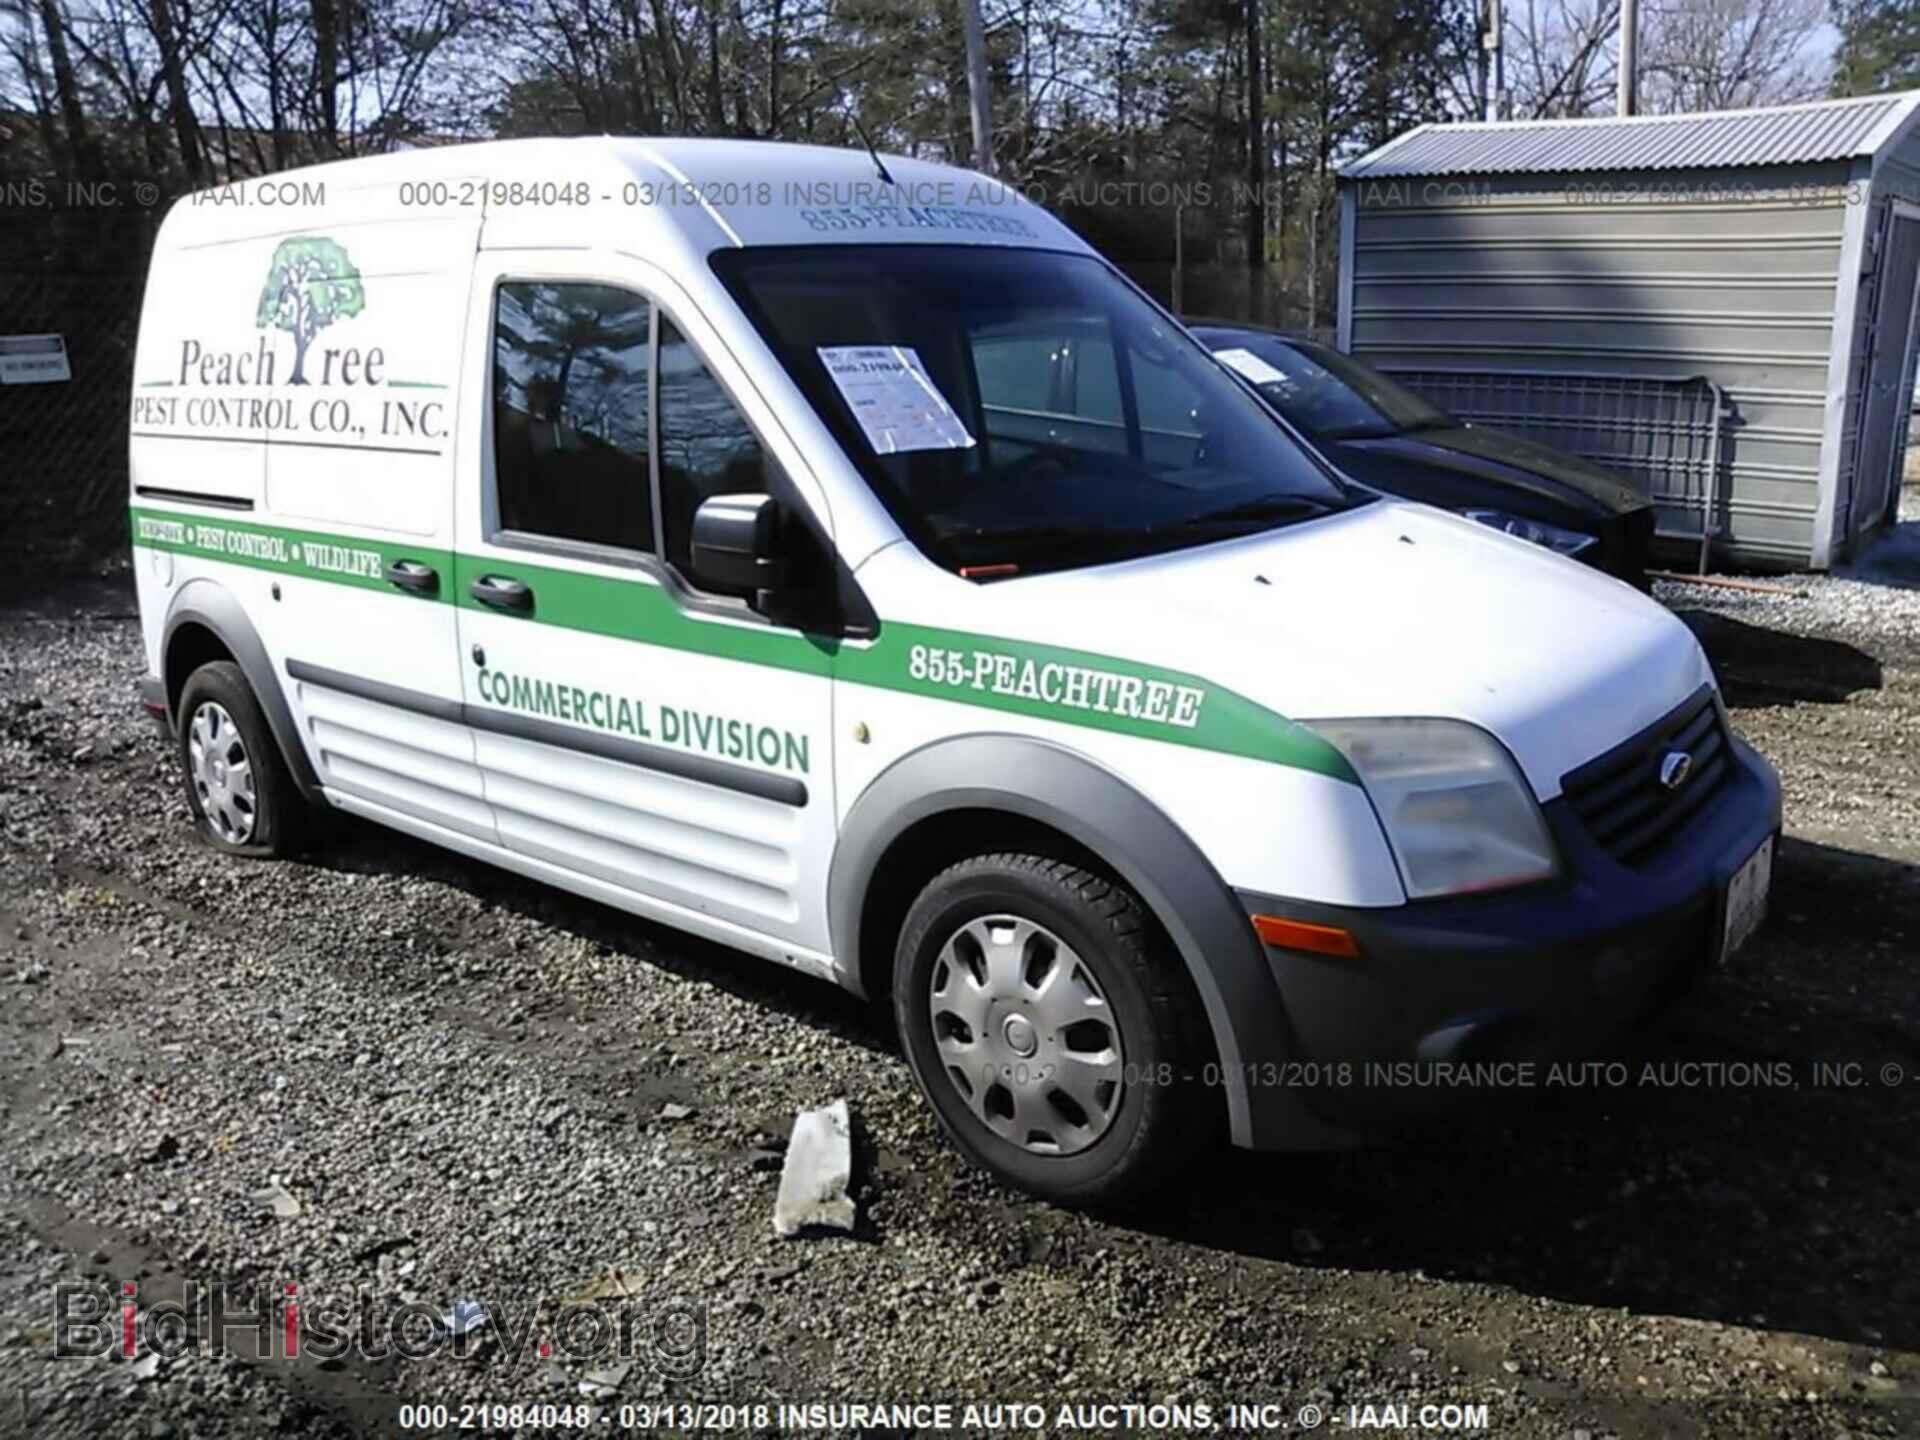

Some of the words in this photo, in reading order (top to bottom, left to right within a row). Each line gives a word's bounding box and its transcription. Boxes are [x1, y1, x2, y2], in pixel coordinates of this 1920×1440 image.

[178, 336, 276, 386] Peach
[133, 397, 178, 426] PEST
[186, 398, 300, 430] CONTROL
[380, 401, 449, 439] INC.
[196, 525, 226, 549] PEST
[227, 530, 289, 563] CONTROL
[302, 542, 383, 579] WILDLIFE
[909, 644, 1204, 729] 855-PEACHTREE
[477, 668, 650, 738] COMMERCIAL
[660, 704, 809, 774] DIVISION
